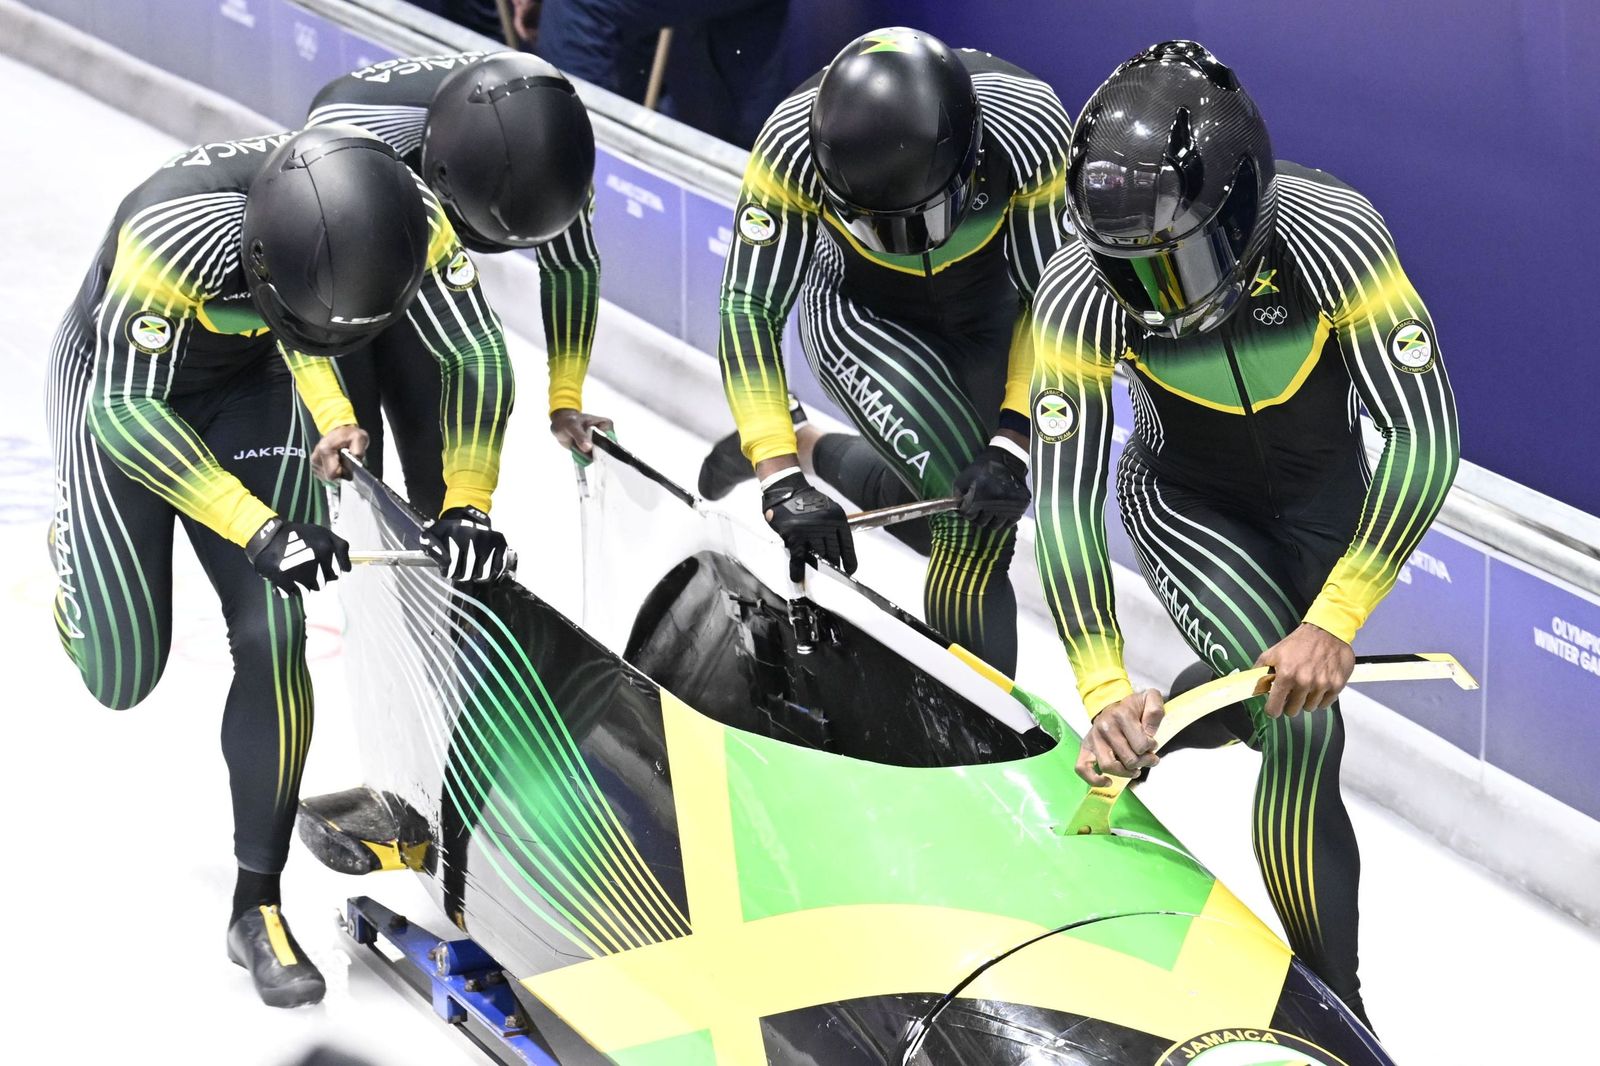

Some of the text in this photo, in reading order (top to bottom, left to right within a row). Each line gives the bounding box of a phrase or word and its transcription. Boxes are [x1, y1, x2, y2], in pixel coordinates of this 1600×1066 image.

[826, 352, 931, 479] JAMAICA
[1156, 563, 1240, 676] JAMAIC
[1533, 626, 1580, 666] WINTER
[1180, 1029, 1279, 1059] JAMAICA
